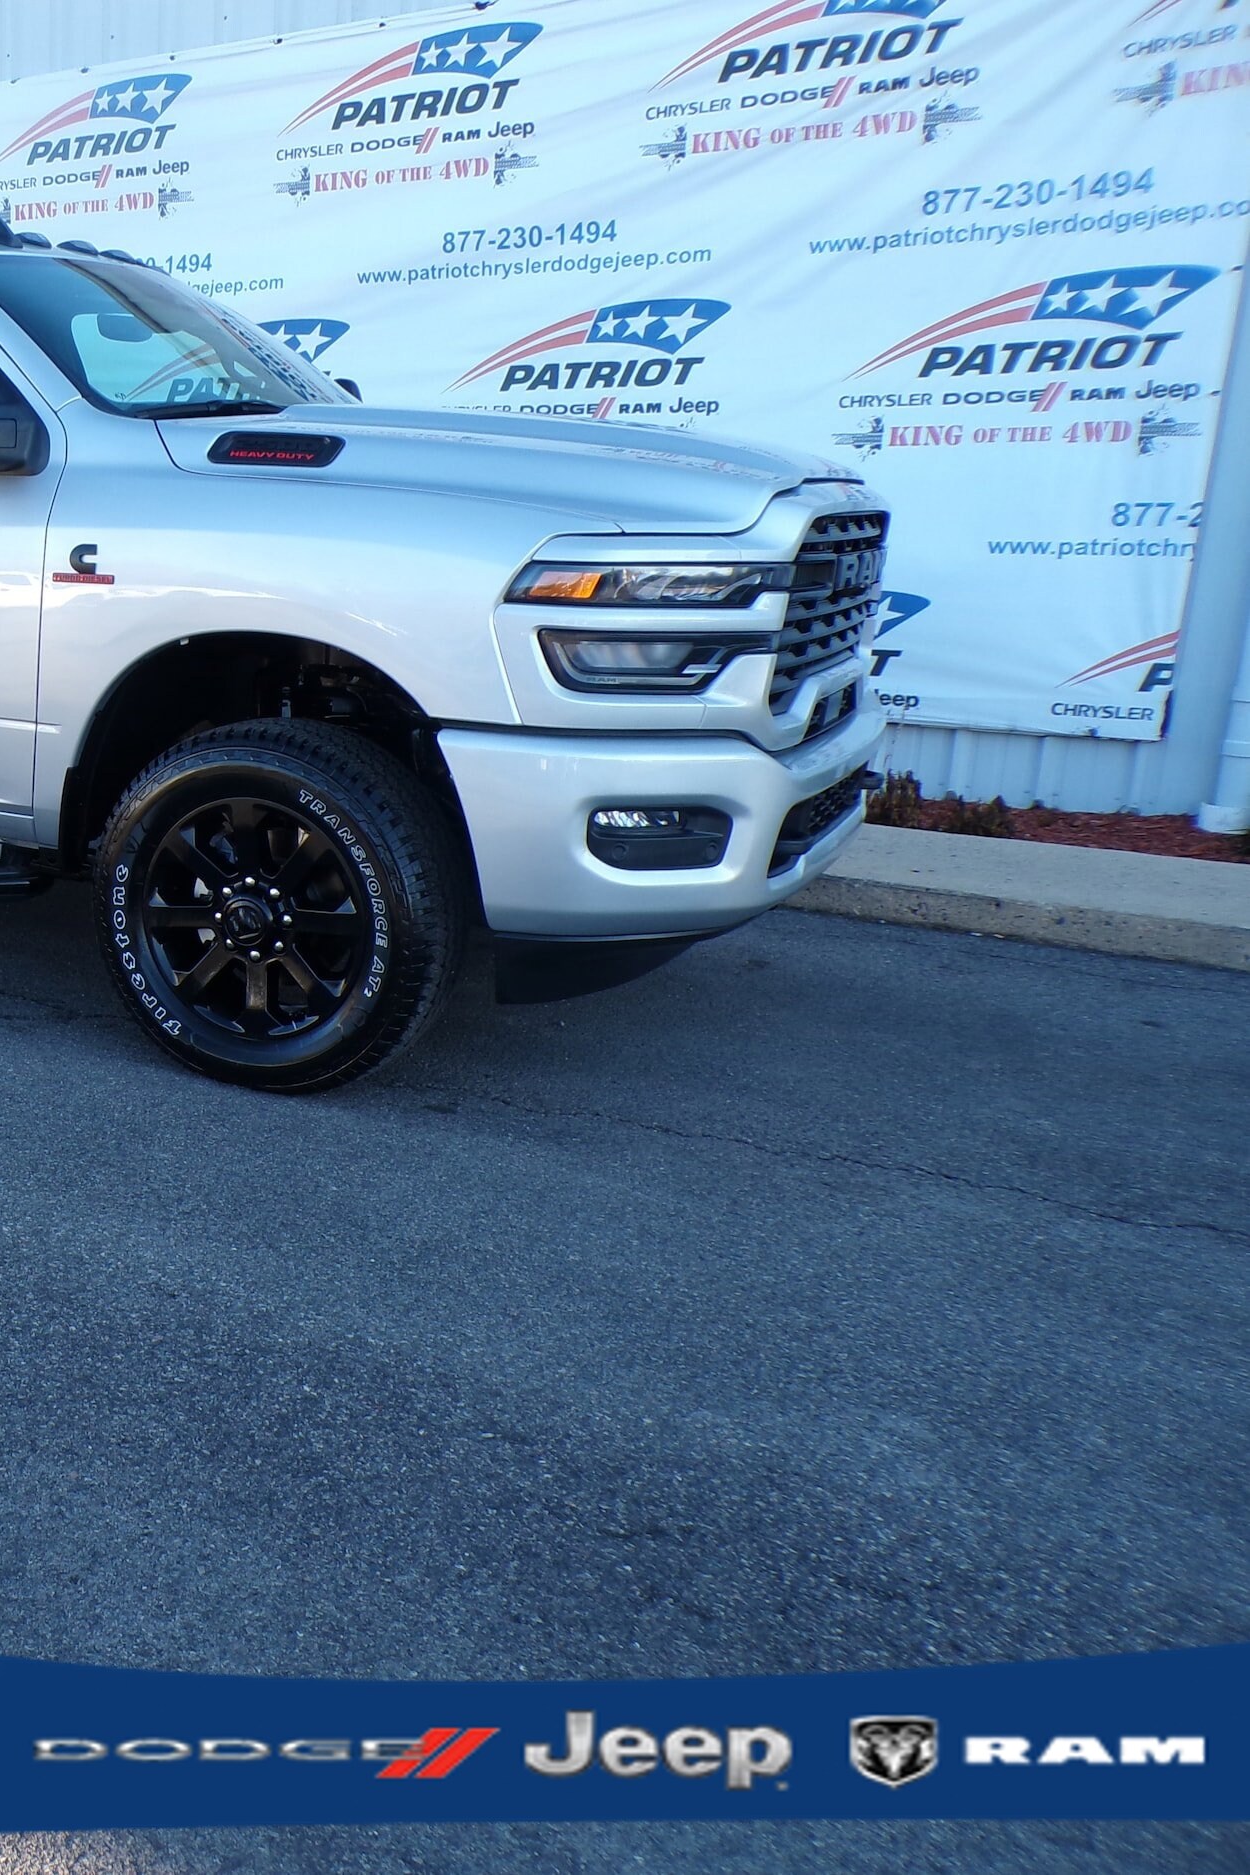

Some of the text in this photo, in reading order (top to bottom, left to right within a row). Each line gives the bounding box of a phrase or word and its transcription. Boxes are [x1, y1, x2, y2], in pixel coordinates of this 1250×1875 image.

[717, 17, 964, 83] PATRIOT
[1122, 24, 1238, 58] CHRYSLER
[330, 79, 519, 130] PATRIOT
[645, 65, 980, 121] CHRYSLER DODGE RAM Jeep
[26, 124, 177, 166] PATRIOT
[276, 120, 535, 161] CHRYSLER DODGE RAM Jeep
[691, 110, 918, 154] KING OF THE 4WD
[43, 170, 101, 186] DODGE
[115, 166, 147, 179] RAM
[152, 160, 190, 176] Jeep
[314, 158, 490, 193] KING OF THE 4WD
[14, 191, 155, 221] KING OF THE 4WD
[922, 167, 1155, 217] 877-230-1494
[442, 219, 617, 253] 877-230-1494
[809, 199, 1250, 255] www.patriotchryslerdodgejeep.co
[357, 248, 712, 285] www.patriotchryslerdodgejeep.com
[917, 331, 1183, 378] PATRIOT
[499, 357, 705, 392] PATRIOT
[519, 403, 598, 416] DODGE
[618, 402, 662, 415] RAM
[669, 396, 719, 416] Jeep
[838, 380, 1201, 409] CHRYSLER DODGE RAM Jeep
[888, 421, 1133, 447] KING OF THE 4WD
[230, 450, 315, 460] HEAVY DUTY
[1050, 702, 1155, 721] CHRYSLER
[299, 789, 388, 948] TRANSFORCE
[113, 864, 182, 1036] Firestone
